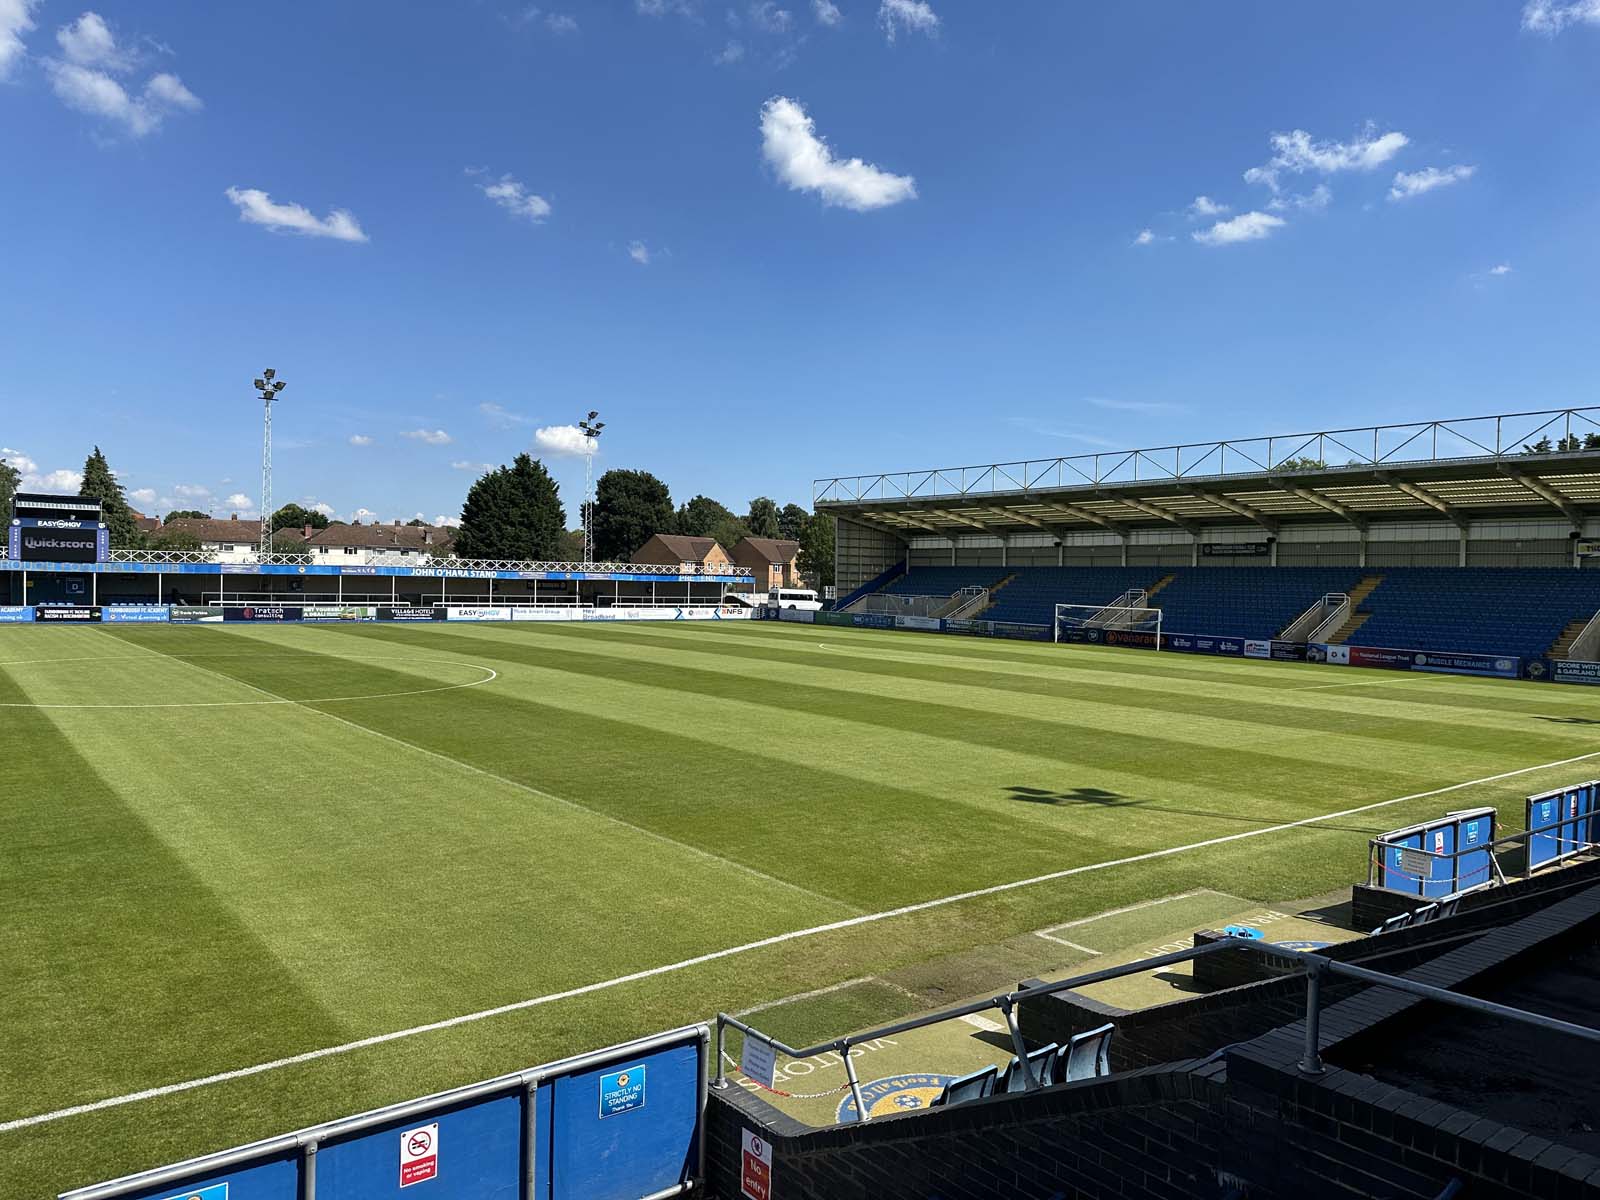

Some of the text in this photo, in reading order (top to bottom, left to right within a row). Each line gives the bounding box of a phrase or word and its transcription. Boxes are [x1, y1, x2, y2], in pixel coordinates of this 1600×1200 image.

[411, 568, 498, 579] JOHN O'HARA STAND
[1562, 668, 1596, 676] GARLAND
[604, 1083, 642, 1101] STRICTLY NO
[608, 1093, 637, 1107] STANDING
[412, 1160, 434, 1171] smoking
[413, 1167, 431, 1176] vaping
[749, 1159, 763, 1176] No
[745, 1177, 767, 1199] entry
